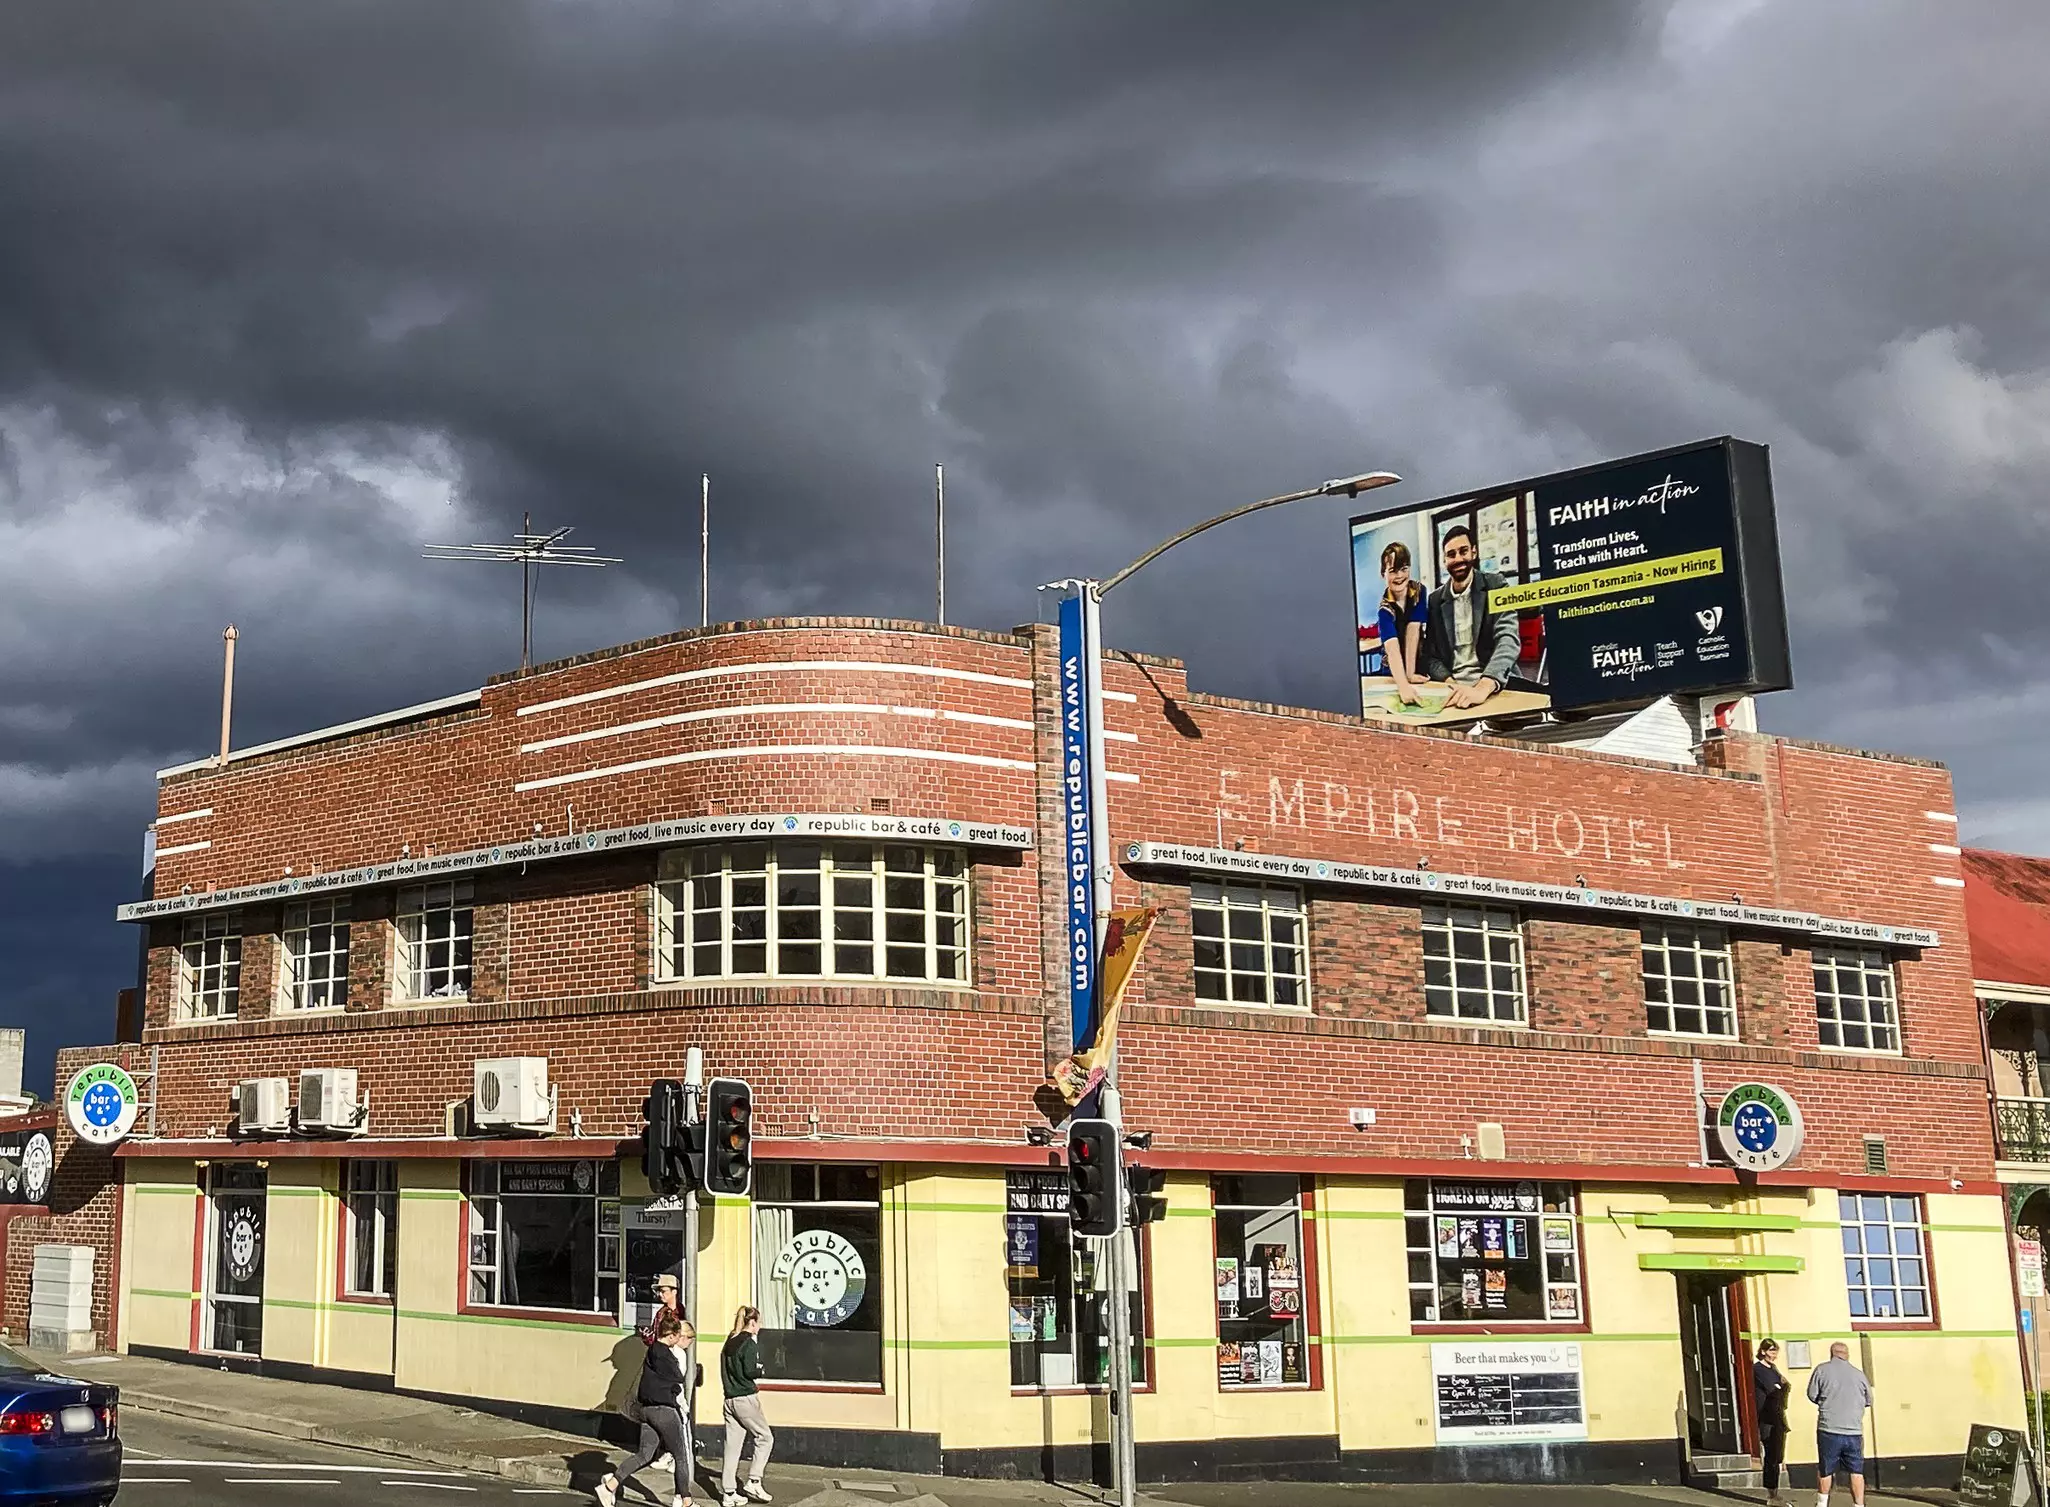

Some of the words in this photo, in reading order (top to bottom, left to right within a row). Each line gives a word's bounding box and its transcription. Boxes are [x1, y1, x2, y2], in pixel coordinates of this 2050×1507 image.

[1612, 498, 1636, 511] in
[1637, 473, 1699, 514] action
[1552, 535, 1607, 556] Transform
[1608, 530, 1639, 545] Lives,
[1553, 555, 1586, 570] Teach
[1587, 550, 1612, 564] with
[1613, 543, 1648, 560] Heart.
[1494, 590, 1537, 607] Catholic
[1538, 579, 1590, 599] Education
[1592, 571, 1644, 589] Tasmania
[1653, 566, 1678, 579] Now
[1681, 557, 1716, 574] Hiring
[1557, 595, 1655, 619] faithinaction.com.au
[1592, 642, 1618, 653] Catholic
[1656, 640, 1678, 651] Teach
[1696, 643, 1730, 654] Education
[1698, 635, 1726, 645] Catholic
[1657, 648, 1685, 660] Support
[1699, 651, 1730, 661] Tasmania
[1601, 668, 1615, 678] in
[1617, 660, 1654, 681] action
[1657, 659, 1674, 668] Care
[808, 819, 866, 833] republic
[871, 821, 895, 833] bar
[896, 821, 908, 833] &
[911, 822, 941, 835] café
[1063, 656, 1089, 990] www.republicbar.com
[1219, 769, 1464, 843] EMPIRE
[1507, 805, 1688, 869] HOTEL
[604, 834, 627, 848] great
[629, 828, 652, 841] food,
[654, 826, 672, 838] live
[674, 821, 706, 836] music
[710, 820, 746, 836] every
[750, 818, 775, 833] day
[969, 828, 997, 840] great
[1002, 829, 1030, 845] food,
[504, 844, 536, 860] republic
[538, 842, 552, 856] bar
[553, 841, 560, 852] &
[562, 836, 581, 851] café
[377, 866, 395, 880] great
[396, 861, 417, 876] food,
[417, 860, 429, 873] live
[430, 856, 451, 870] music
[453, 854, 474, 869] every
[475, 852, 490, 867] day
[1151, 848, 1178, 860] great
[1182, 850, 1209, 865] food,
[1209, 852, 1228, 866] live
[1230, 855, 1260, 869] music
[1262, 860, 1289, 873] every
[1292, 862, 1311, 876] day
[302, 877, 327, 891] republic
[328, 875, 340, 888] bar
[340, 874, 347, 885] &
[347, 869, 363, 883] café
[1333, 867, 1370, 881] republic
[1373, 871, 1389, 883] bar
[1391, 872, 1398, 884] &
[1400, 873, 1421, 886] café
[197, 895, 213, 907] great
[229, 891, 239, 901] live
[241, 888, 259, 899] music
[259, 884, 277, 897] every
[278, 882, 290, 894] day
[1444, 879, 1469, 890] great
[1472, 881, 1495, 894] food,
[1495, 883, 1510, 894] live
[1511, 886, 1537, 897] music
[1539, 890, 1562, 901] every
[1565, 890, 1581, 903] day
[135, 902, 157, 916] republic
[157, 902, 168, 912] bar
[1600, 895, 1632, 908] republic
[1635, 898, 1649, 909] bar
[1650, 899, 1657, 910] &
[1659, 901, 1678, 912] café
[1696, 907, 1716, 917] great
[1720, 907, 1742, 920] food,
[1744, 909, 1758, 920] live
[1759, 912, 1780, 923] music
[1782, 916, 1804, 927] every
[1806, 916, 1820, 929] day
[1840, 924, 1853, 935] bar
[1853, 925, 1860, 935] &
[1861, 928, 1879, 937] café
[1894, 931, 1914, 942] great
[74, 1069, 134, 1101] republic
[90, 1093, 110, 1105] bar
[1722, 1088, 1789, 1124] republic
[96, 1106, 104, 1115] &
[82, 1123, 121, 1137] café
[1741, 1116, 1763, 1127] bar
[1750, 1130, 1758, 1140] &
[1737, 1149, 1780, 1165] café
[1010, 1193, 1029, 1209] AND
[1030, 1194, 1055, 1209] DAILY
[226, 1206, 261, 1240] republic
[236, 1232, 247, 1242] bar
[777, 1235, 861, 1278] republic
[803, 1266, 828, 1279] bar
[2024, 1270, 2039, 1280] 1P
[812, 1283, 821, 1294] &
[789, 1303, 848, 1324] café
[1454, 1352, 1476, 1365] Beer
[1478, 1353, 1497, 1364] that
[1499, 1352, 1529, 1364] makes
[1531, 1355, 1547, 1366] you
